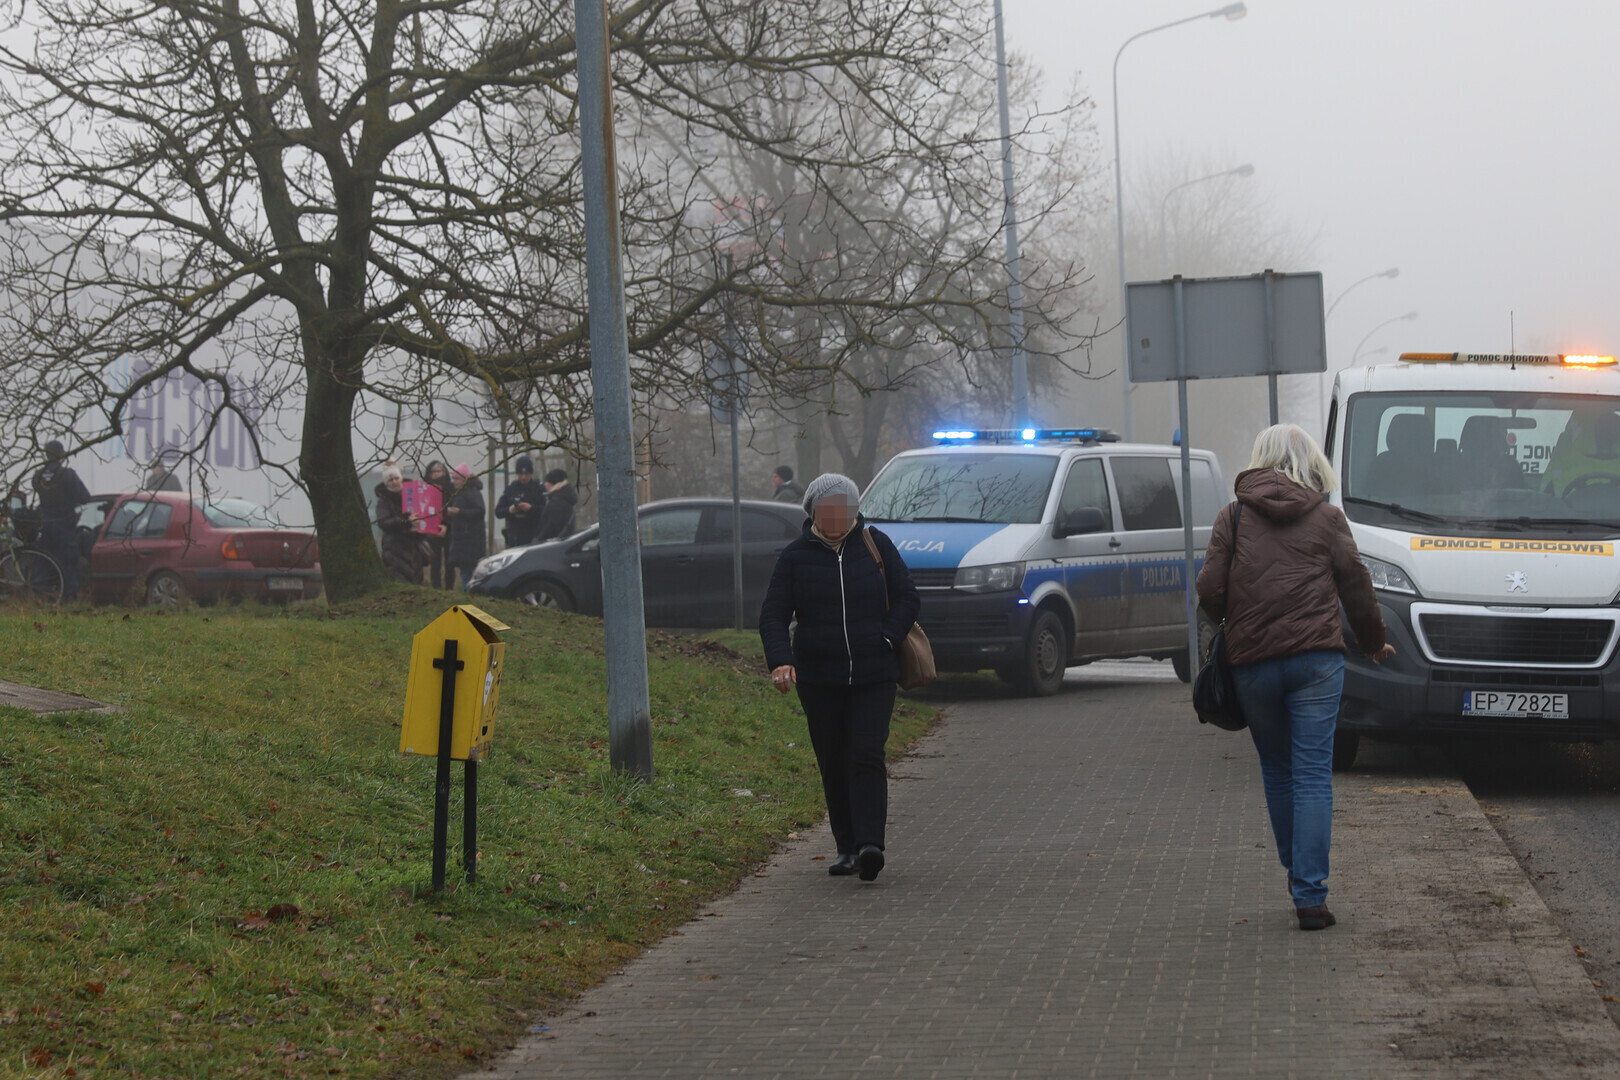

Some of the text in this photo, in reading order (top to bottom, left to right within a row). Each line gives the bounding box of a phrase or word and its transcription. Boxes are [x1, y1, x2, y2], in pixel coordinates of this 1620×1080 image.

[1467, 354, 1549, 363] POMOC DROGOWA
[126, 359, 261, 468] ACTION
[892, 539, 945, 552] ICJA
[1419, 538, 1604, 553] POMOC DROGOWA
[1142, 565, 1182, 587] POLICJA
[1475, 692, 1564, 713] EP 7282E
